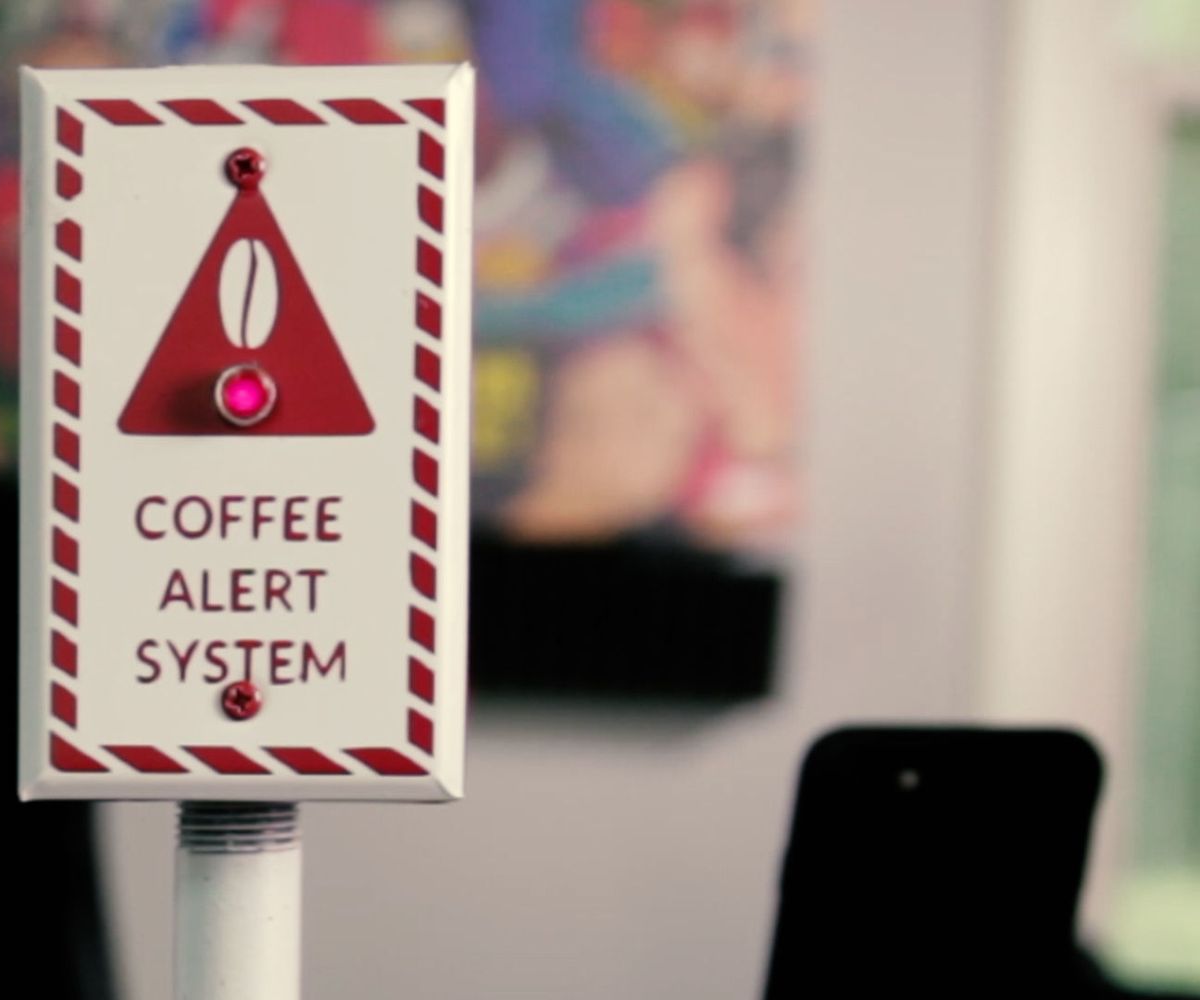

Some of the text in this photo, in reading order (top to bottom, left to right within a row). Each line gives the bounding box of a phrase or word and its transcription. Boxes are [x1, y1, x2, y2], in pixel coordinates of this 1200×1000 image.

[135, 495, 342, 542] COFFEE
[159, 568, 327, 612] ALERT
[136, 639, 346, 684] SYSTEM
